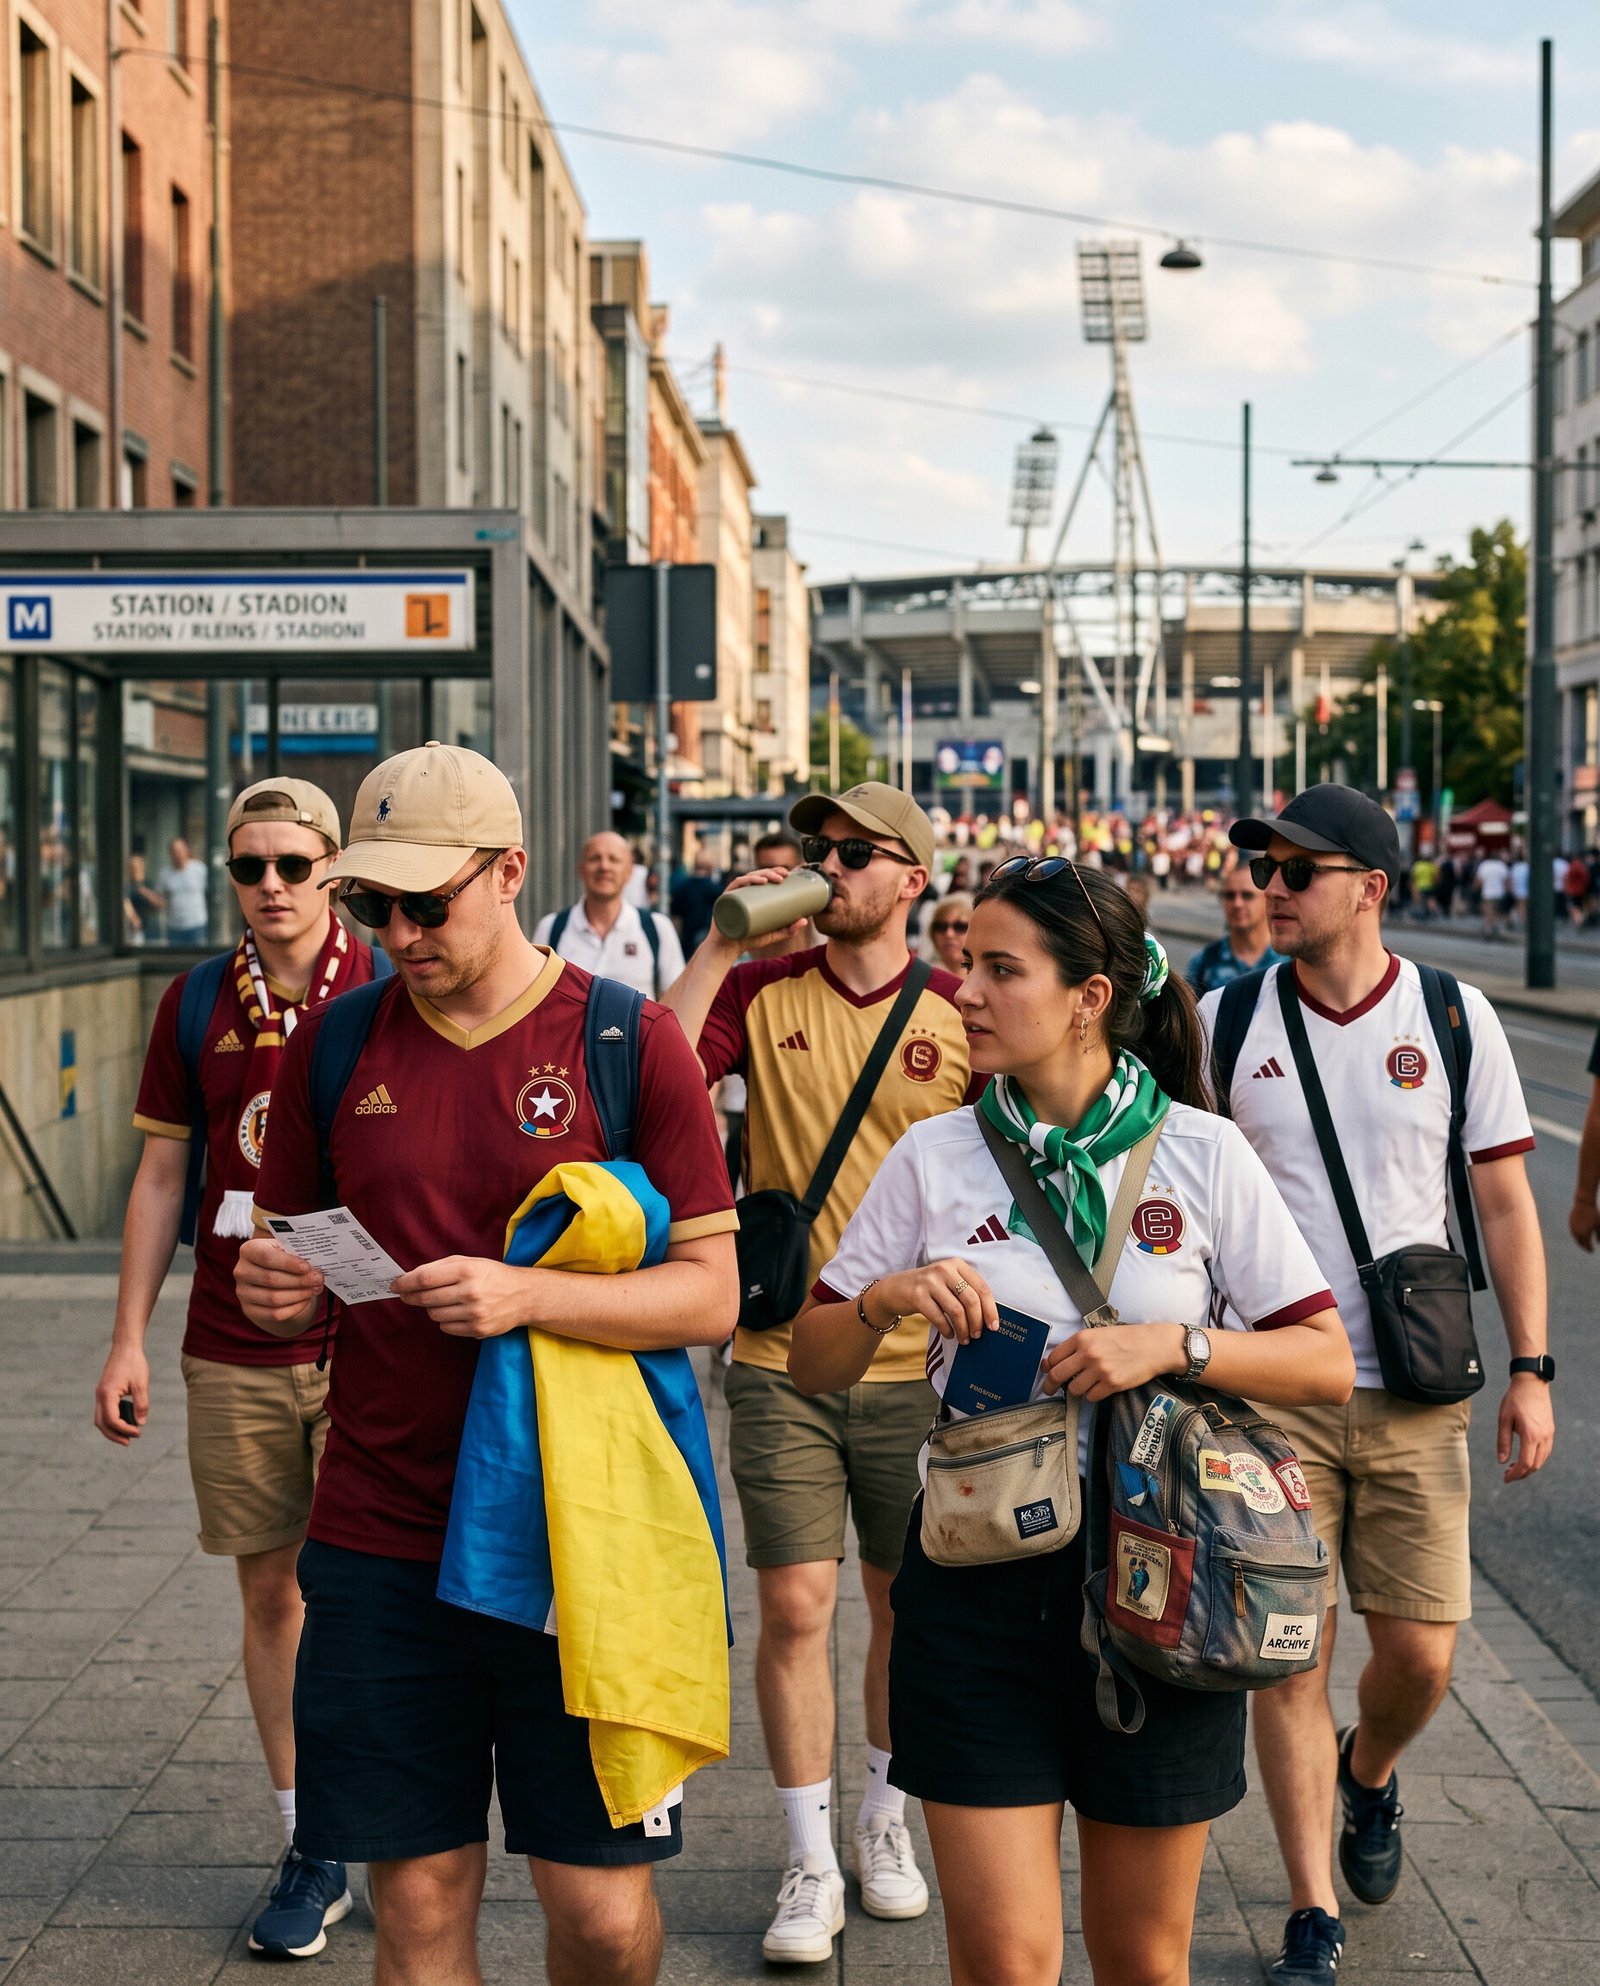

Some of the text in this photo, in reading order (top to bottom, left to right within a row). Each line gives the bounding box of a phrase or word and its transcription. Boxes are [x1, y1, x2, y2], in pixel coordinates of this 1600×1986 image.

[111, 593, 348, 616] STATION / STADION
[14, 602, 47, 633] M
[93, 622, 173, 641] STATION
[214, 1043, 245, 1053] adidas
[355, 1103, 398, 1115] adidas
[1266, 1637, 1311, 1650] ARCHIVE
